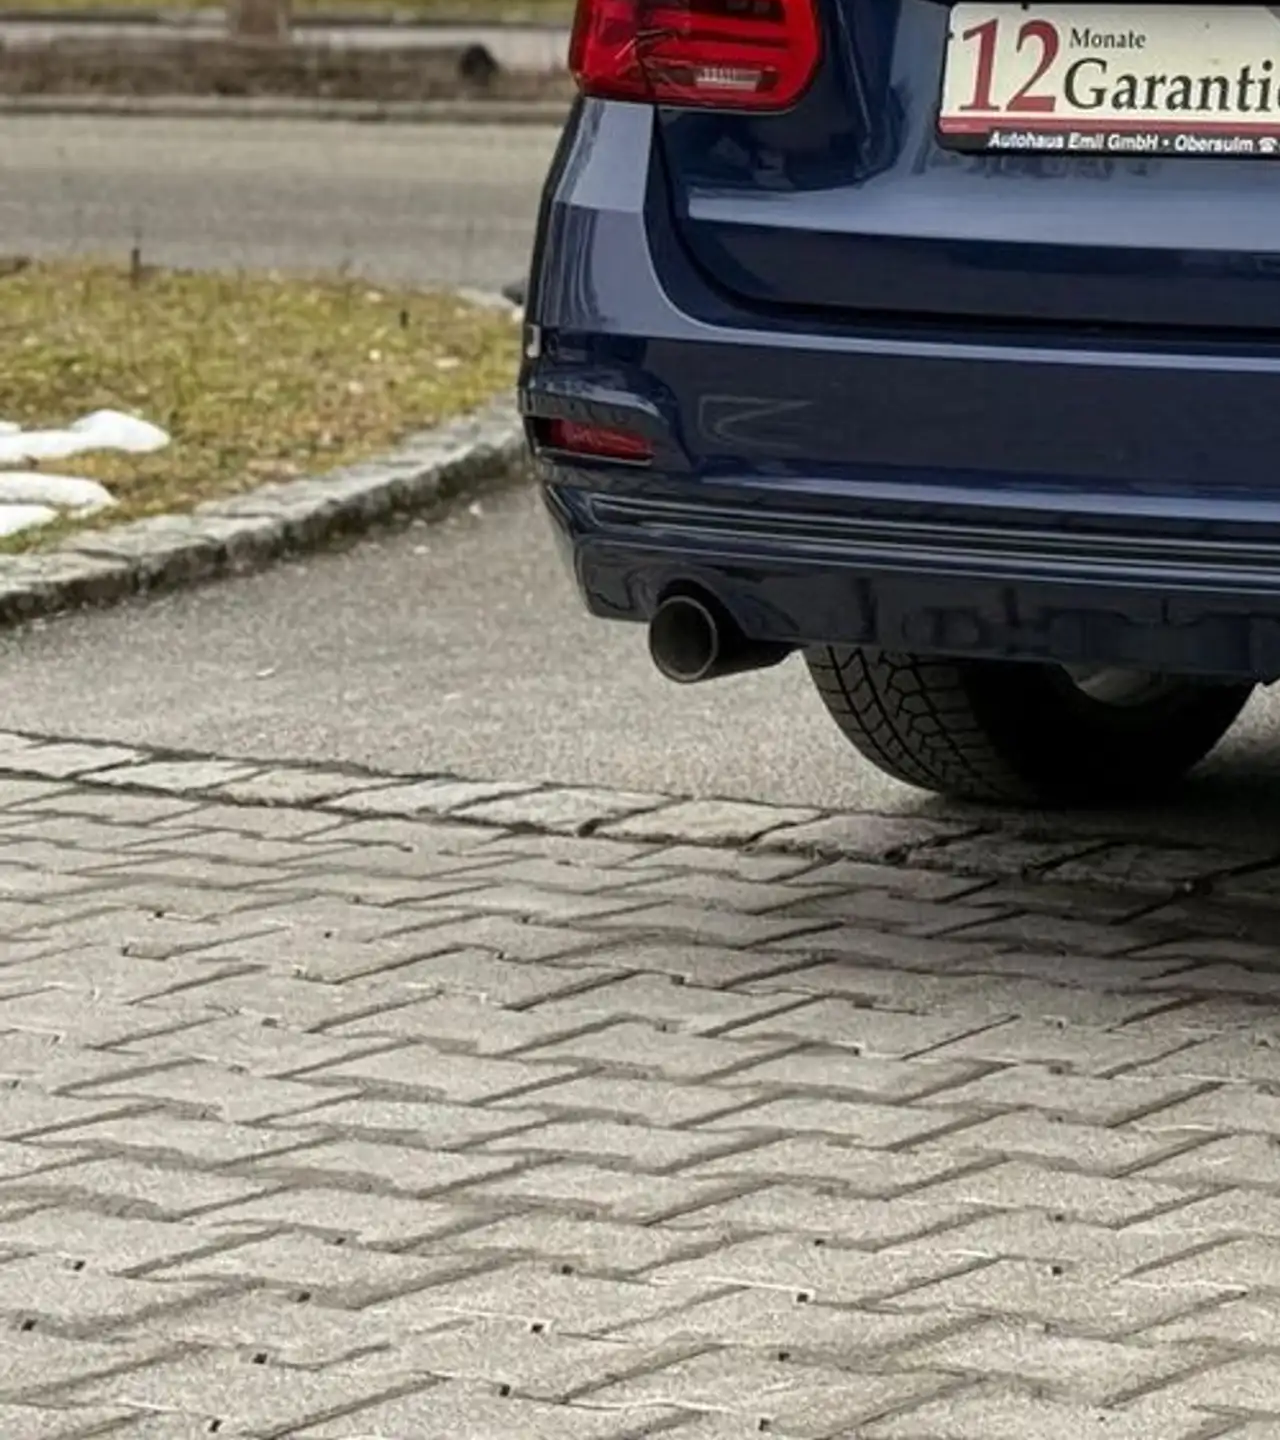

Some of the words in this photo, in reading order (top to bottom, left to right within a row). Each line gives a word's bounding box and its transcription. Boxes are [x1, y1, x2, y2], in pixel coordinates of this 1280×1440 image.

[1069, 28, 1147, 50] Monate
[958, 18, 1060, 113] 12
[988, 131, 1064, 149] Autohaus
[1108, 133, 1159, 151] GmbH
[1174, 134, 1254, 153] Obersulm
